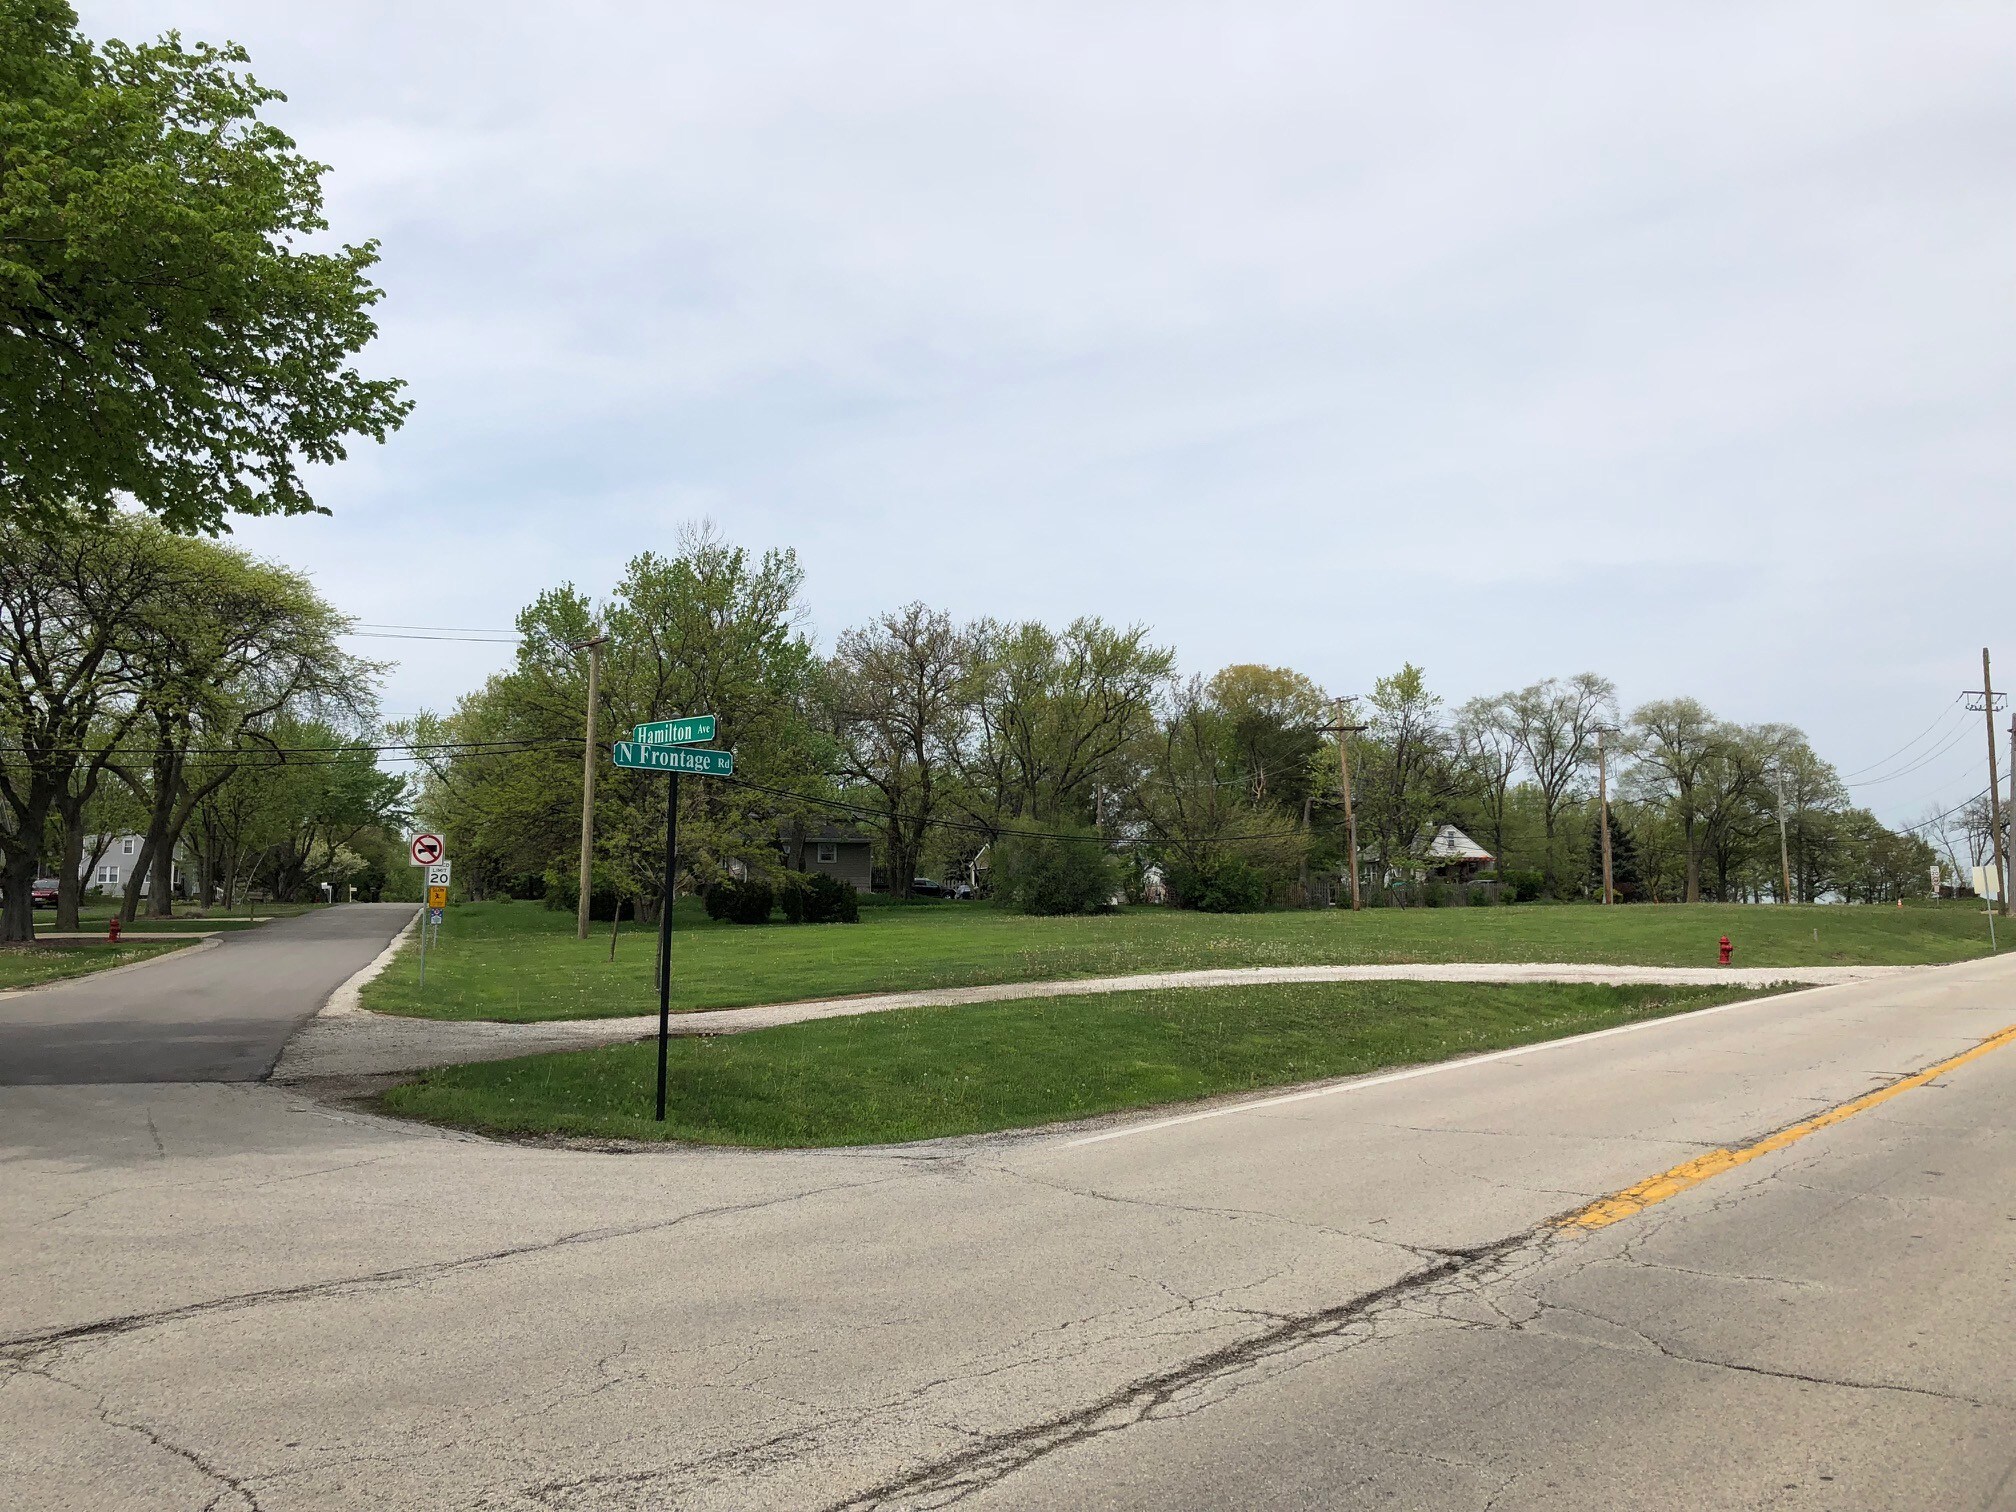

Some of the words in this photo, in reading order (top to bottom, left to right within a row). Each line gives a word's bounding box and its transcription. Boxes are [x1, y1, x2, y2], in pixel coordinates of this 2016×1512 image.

[638, 723, 692, 744] Hamilton
[697, 724, 711, 735] Ave
[619, 743, 633, 763] N
[639, 745, 711, 772] Frontage
[717, 757, 730, 769] Rd
[430, 873, 449, 884] 20
